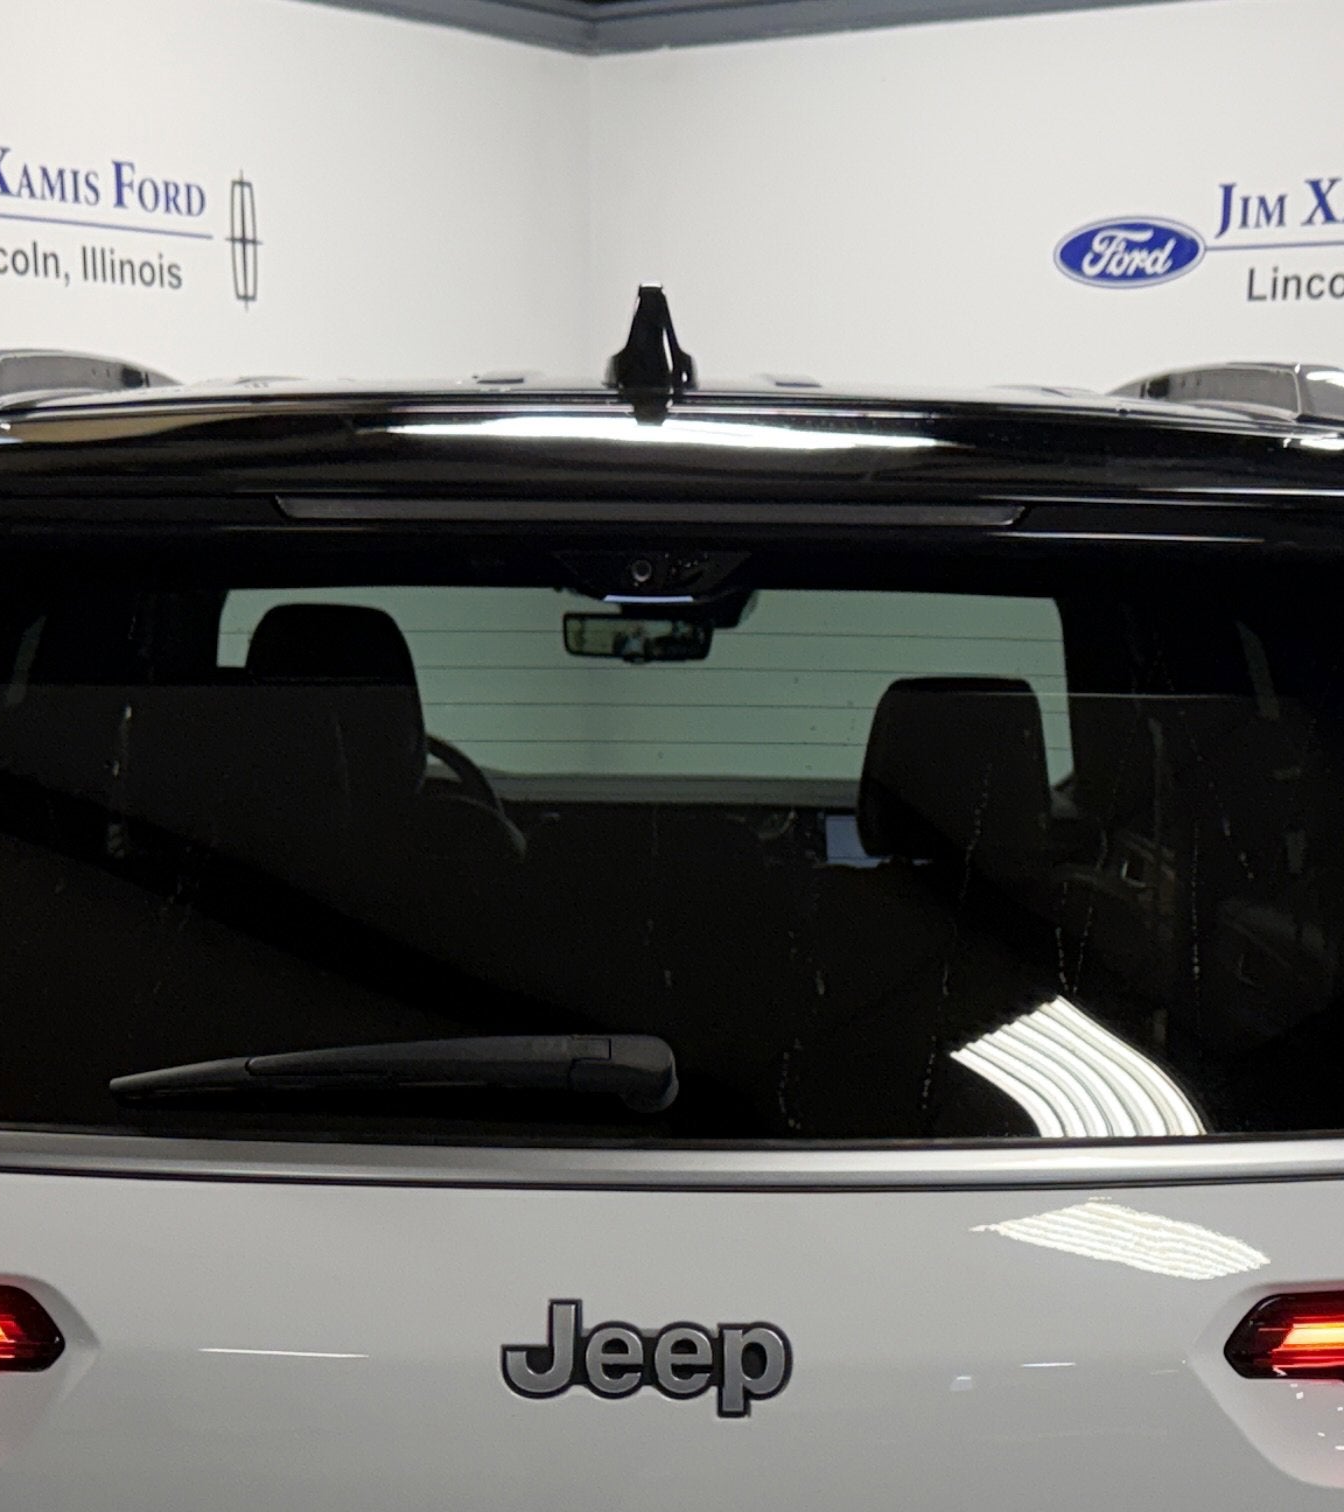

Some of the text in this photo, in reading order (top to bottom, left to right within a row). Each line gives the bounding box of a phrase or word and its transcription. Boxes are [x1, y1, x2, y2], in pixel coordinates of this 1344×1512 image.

[111, 161, 206, 217] FORD
[1214, 182, 1287, 238] JIM
[82, 245, 183, 289] Illinois
[1081, 228, 1174, 278] Ford
[501, 1299, 793, 1417] Jeep
